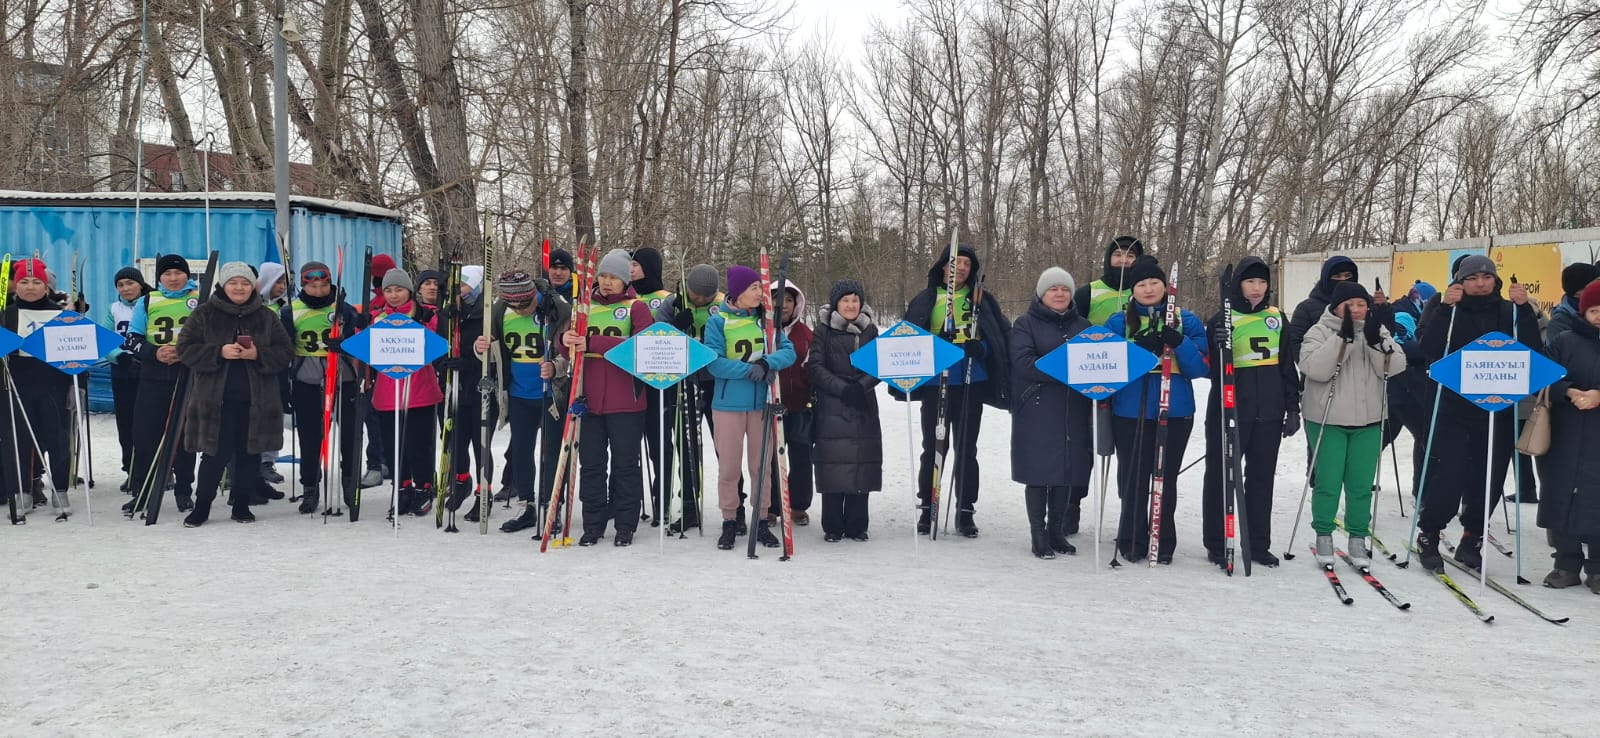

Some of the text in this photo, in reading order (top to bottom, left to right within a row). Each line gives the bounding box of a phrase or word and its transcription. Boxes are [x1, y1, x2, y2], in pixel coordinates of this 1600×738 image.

[946, 256, 957, 317] SALOMON
[505, 332, 544, 358] 29
[1250, 337, 1271, 360] 5
[380, 346, 415, 354] АУДАНЫ
[1086, 351, 1108, 360] МАЙ
[1079, 363, 1117, 371] АУДАНЫ
[1465, 361, 1525, 369] БАЯНАУЫЛ
[1473, 372, 1517, 381] АУДАНЫ
[1153, 494, 1161, 521] TOUR
